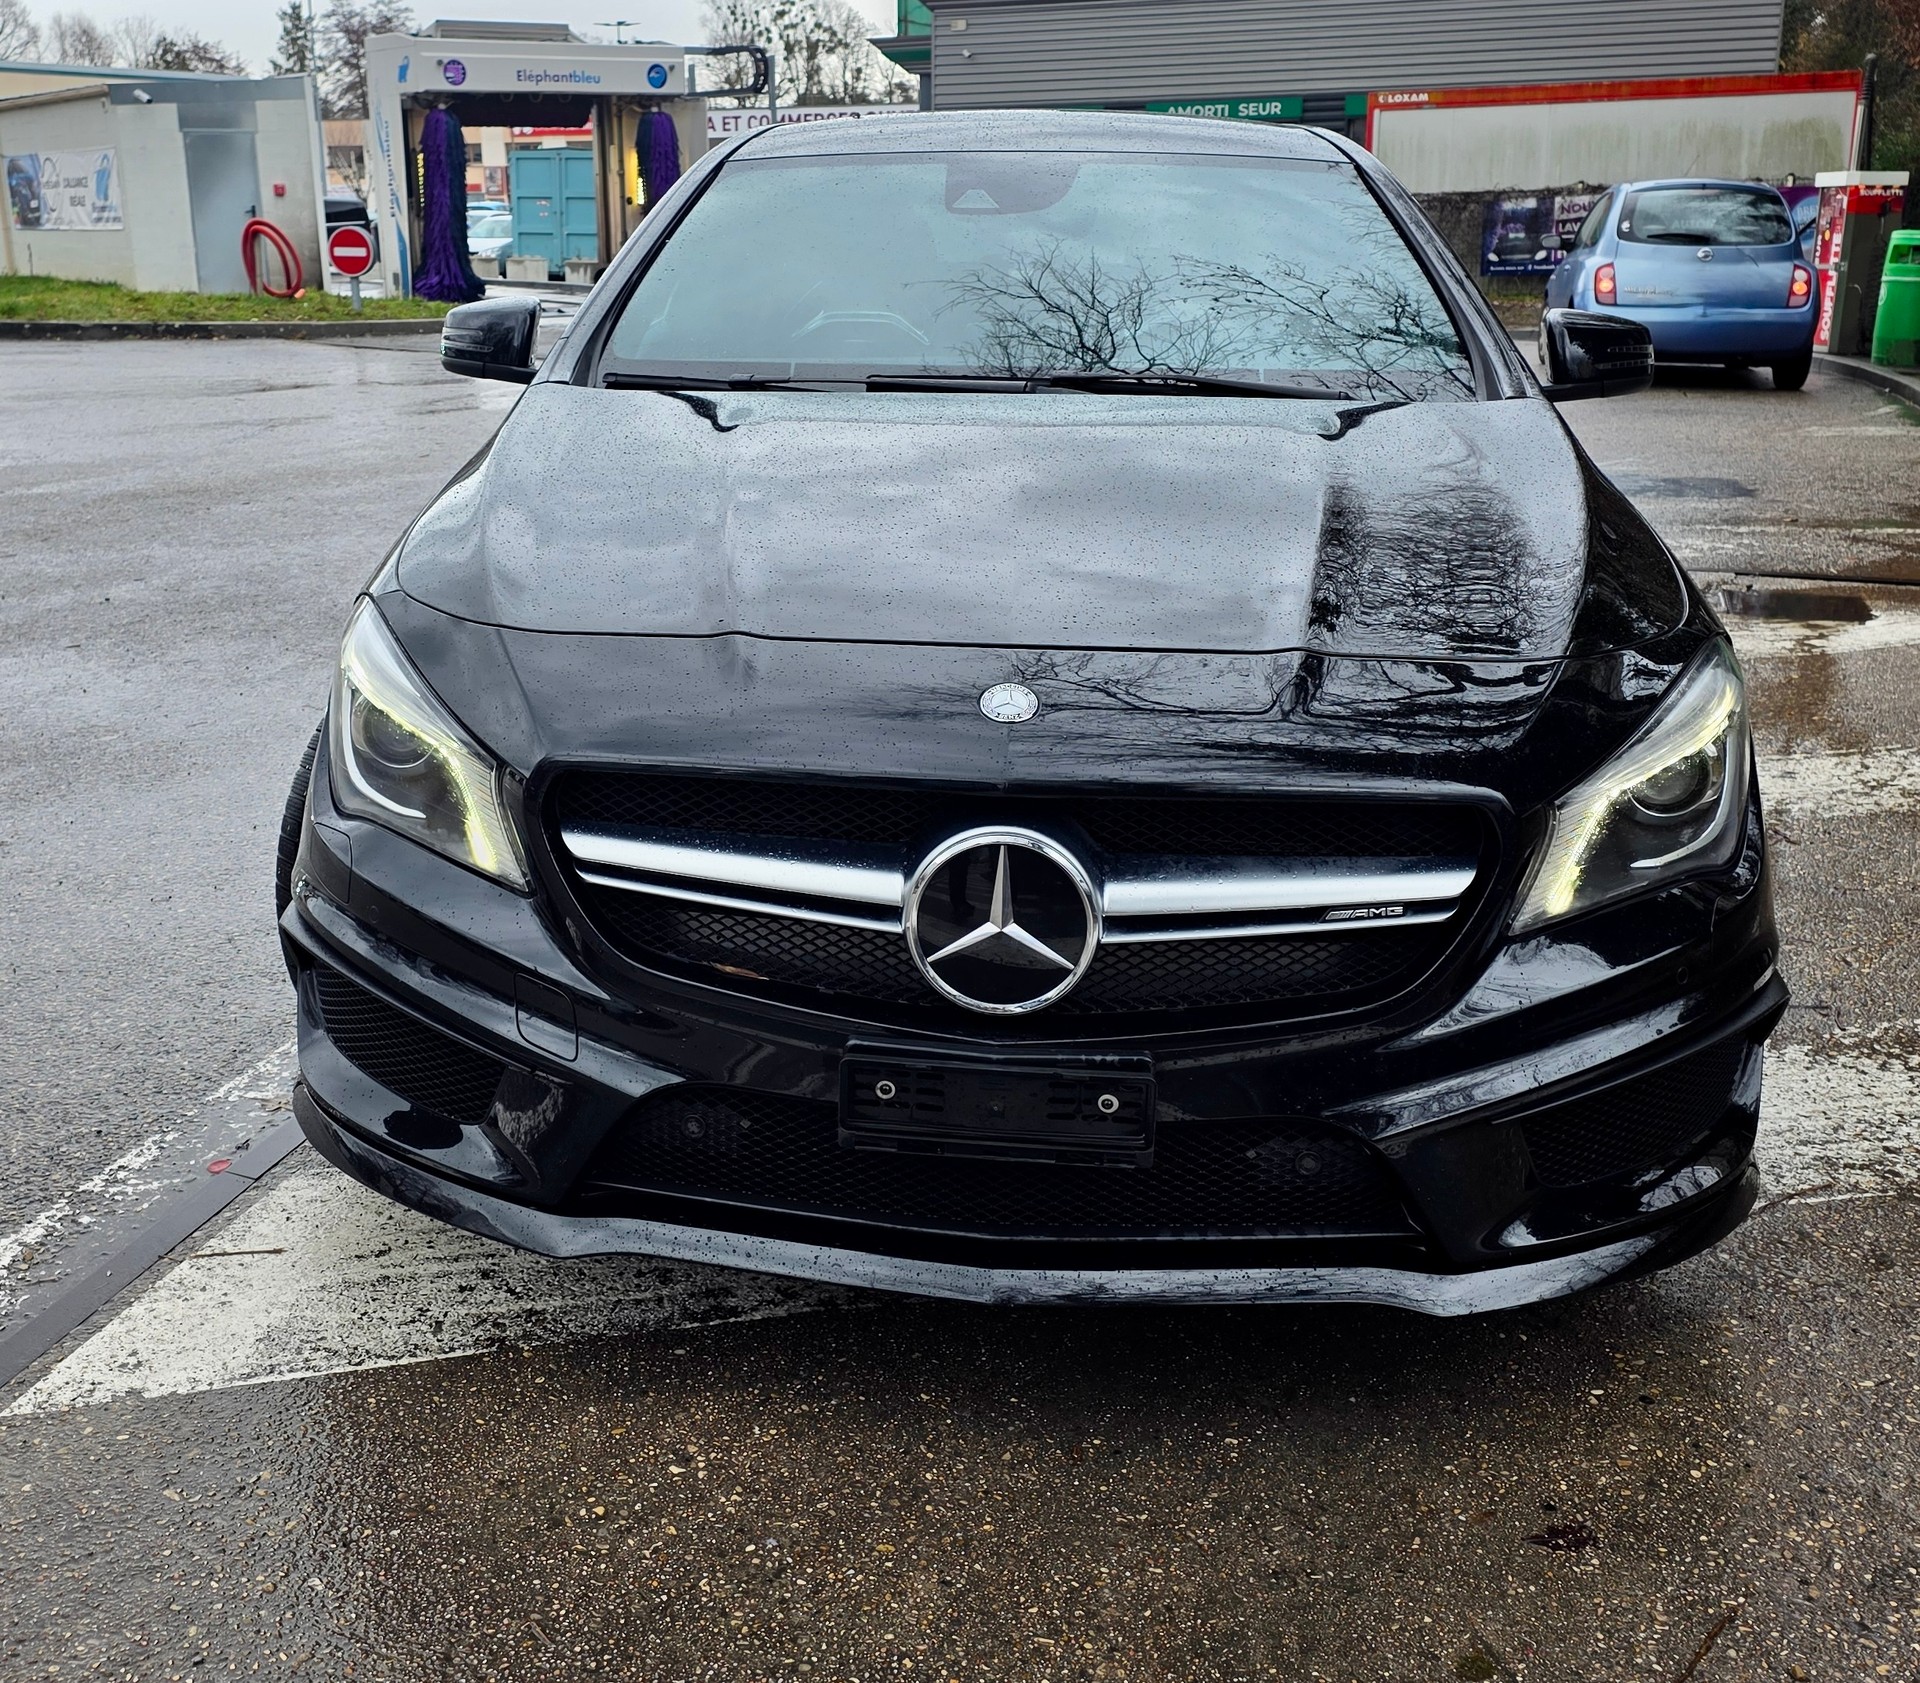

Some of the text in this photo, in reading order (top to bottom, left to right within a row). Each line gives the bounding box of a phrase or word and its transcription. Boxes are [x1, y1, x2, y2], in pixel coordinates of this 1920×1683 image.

[516, 69, 601, 86] Eléphantbleu
[1387, 92, 1429, 104] LOXAM
[1238, 101, 1282, 116] SEUR
[722, 115, 741, 132] ET
[1350, 906, 1404, 918] AMG
